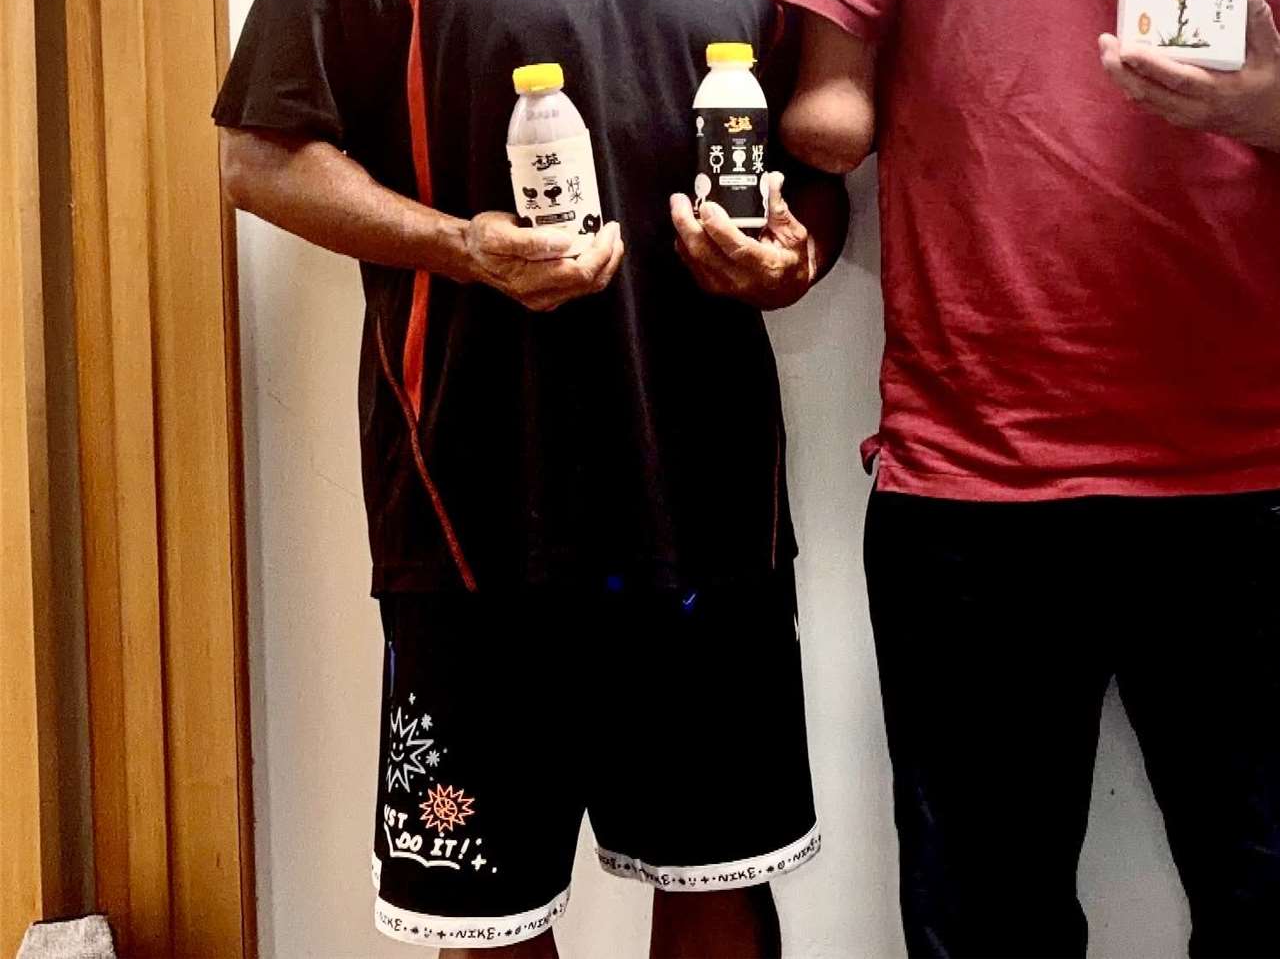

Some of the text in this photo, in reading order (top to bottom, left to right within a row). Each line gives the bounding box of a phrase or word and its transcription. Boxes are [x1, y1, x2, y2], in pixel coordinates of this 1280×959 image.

[430, 838, 470, 859] IT!
[717, 866, 756, 882] NIKE
[455, 927, 496, 941] NIKE
